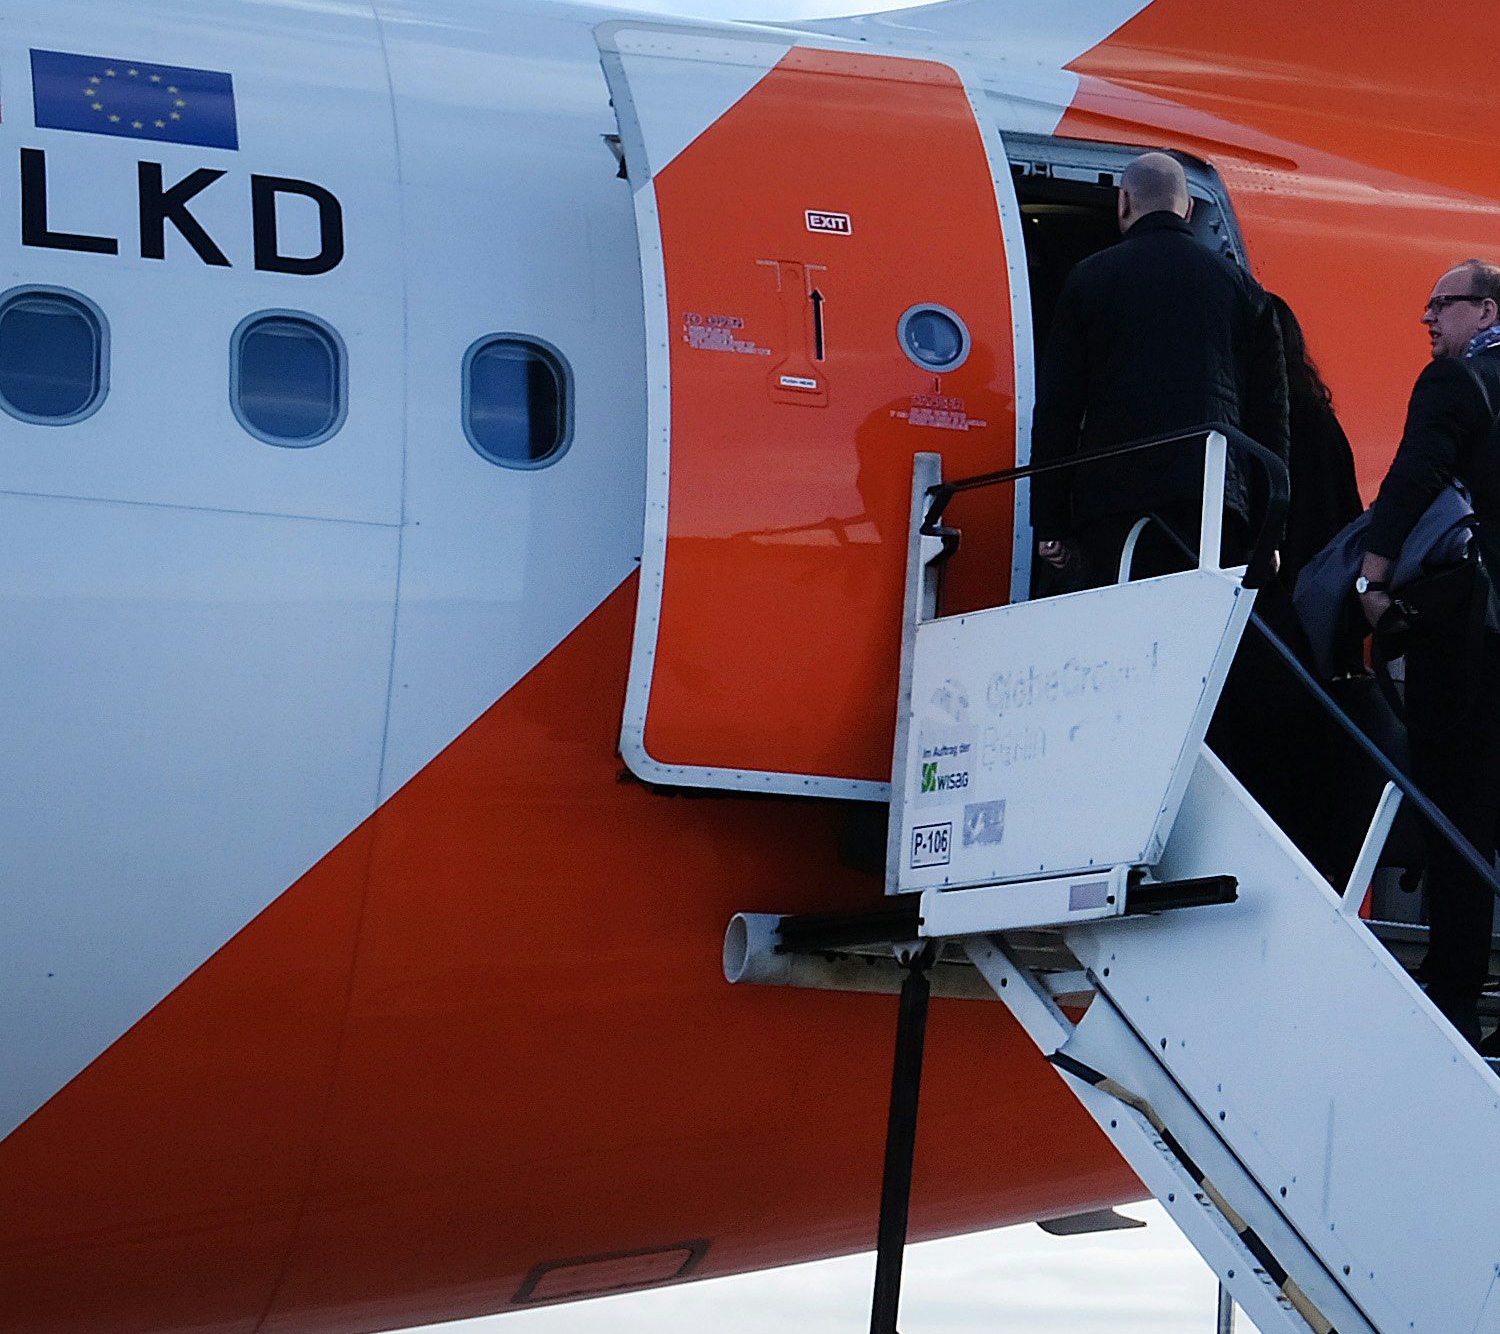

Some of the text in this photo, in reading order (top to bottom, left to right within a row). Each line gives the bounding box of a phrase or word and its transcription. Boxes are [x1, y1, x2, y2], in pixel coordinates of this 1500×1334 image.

[20, 147, 345, 276] LKD
[809, 214, 846, 230] EXIT
[933, 745, 958, 758] Auftrag
[914, 829, 949, 856] P-106
